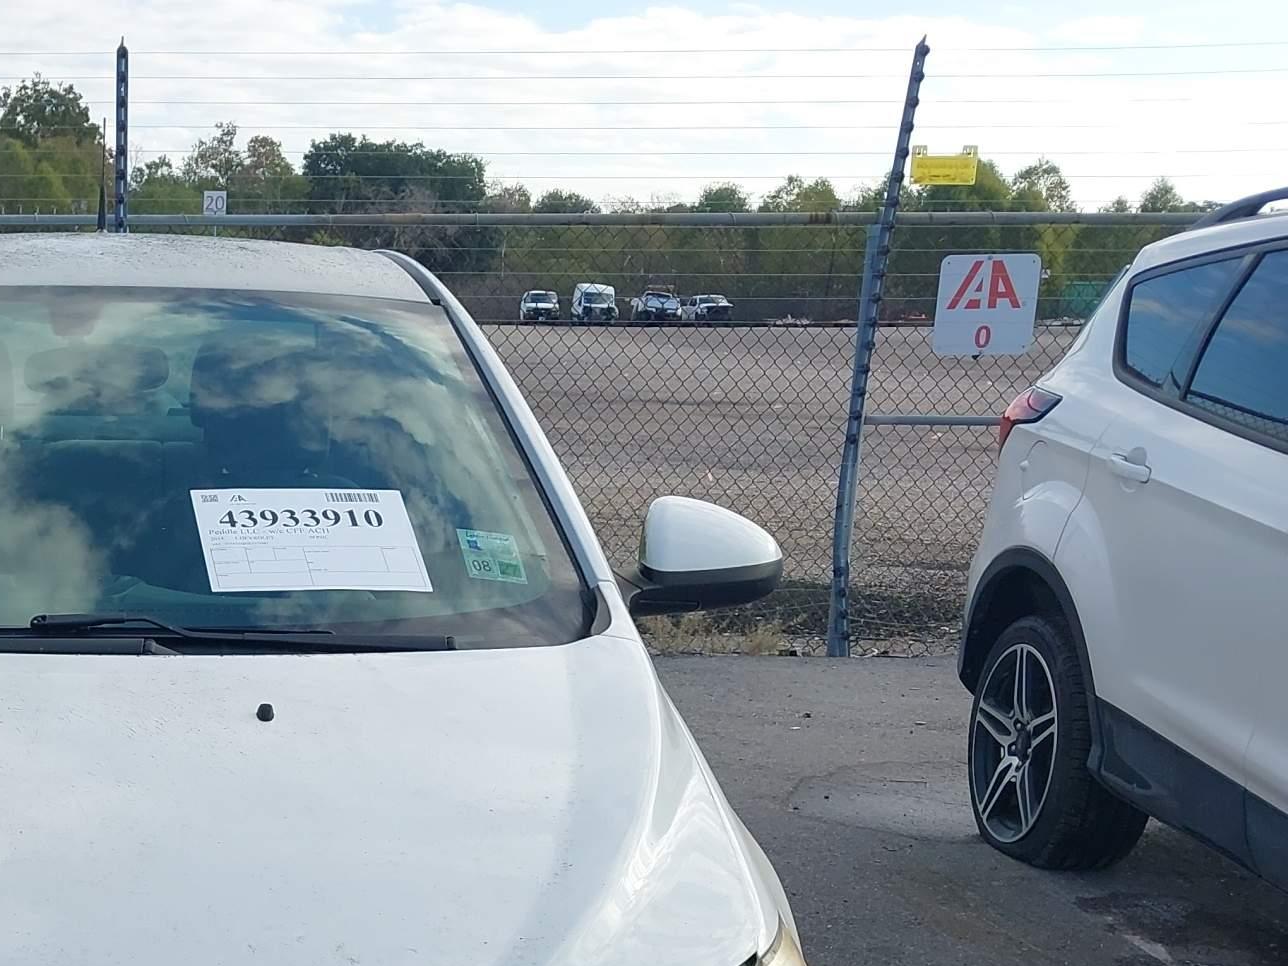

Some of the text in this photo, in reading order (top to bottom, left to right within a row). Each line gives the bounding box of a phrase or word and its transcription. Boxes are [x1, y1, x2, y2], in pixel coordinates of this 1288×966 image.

[205, 195, 225, 210] 20
[975, 325, 991, 348] 0
[219, 508, 383, 528] 43933910
